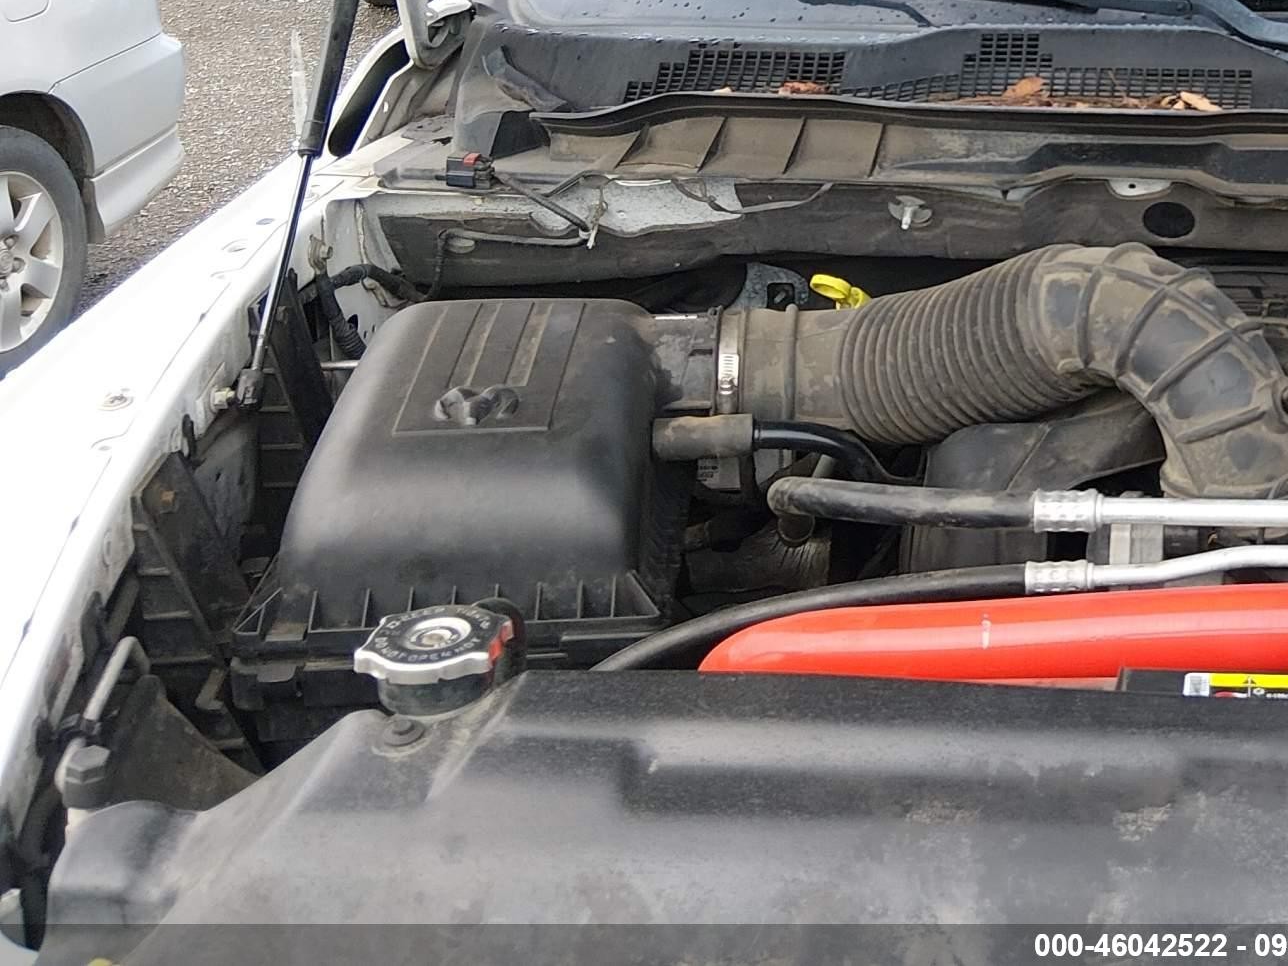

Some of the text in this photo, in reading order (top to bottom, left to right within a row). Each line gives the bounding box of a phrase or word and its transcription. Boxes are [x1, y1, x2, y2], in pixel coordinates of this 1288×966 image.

[381, 648, 408, 659] NOT
[407, 651, 453, 662] OPEN
[454, 637, 481, 653] HOT
